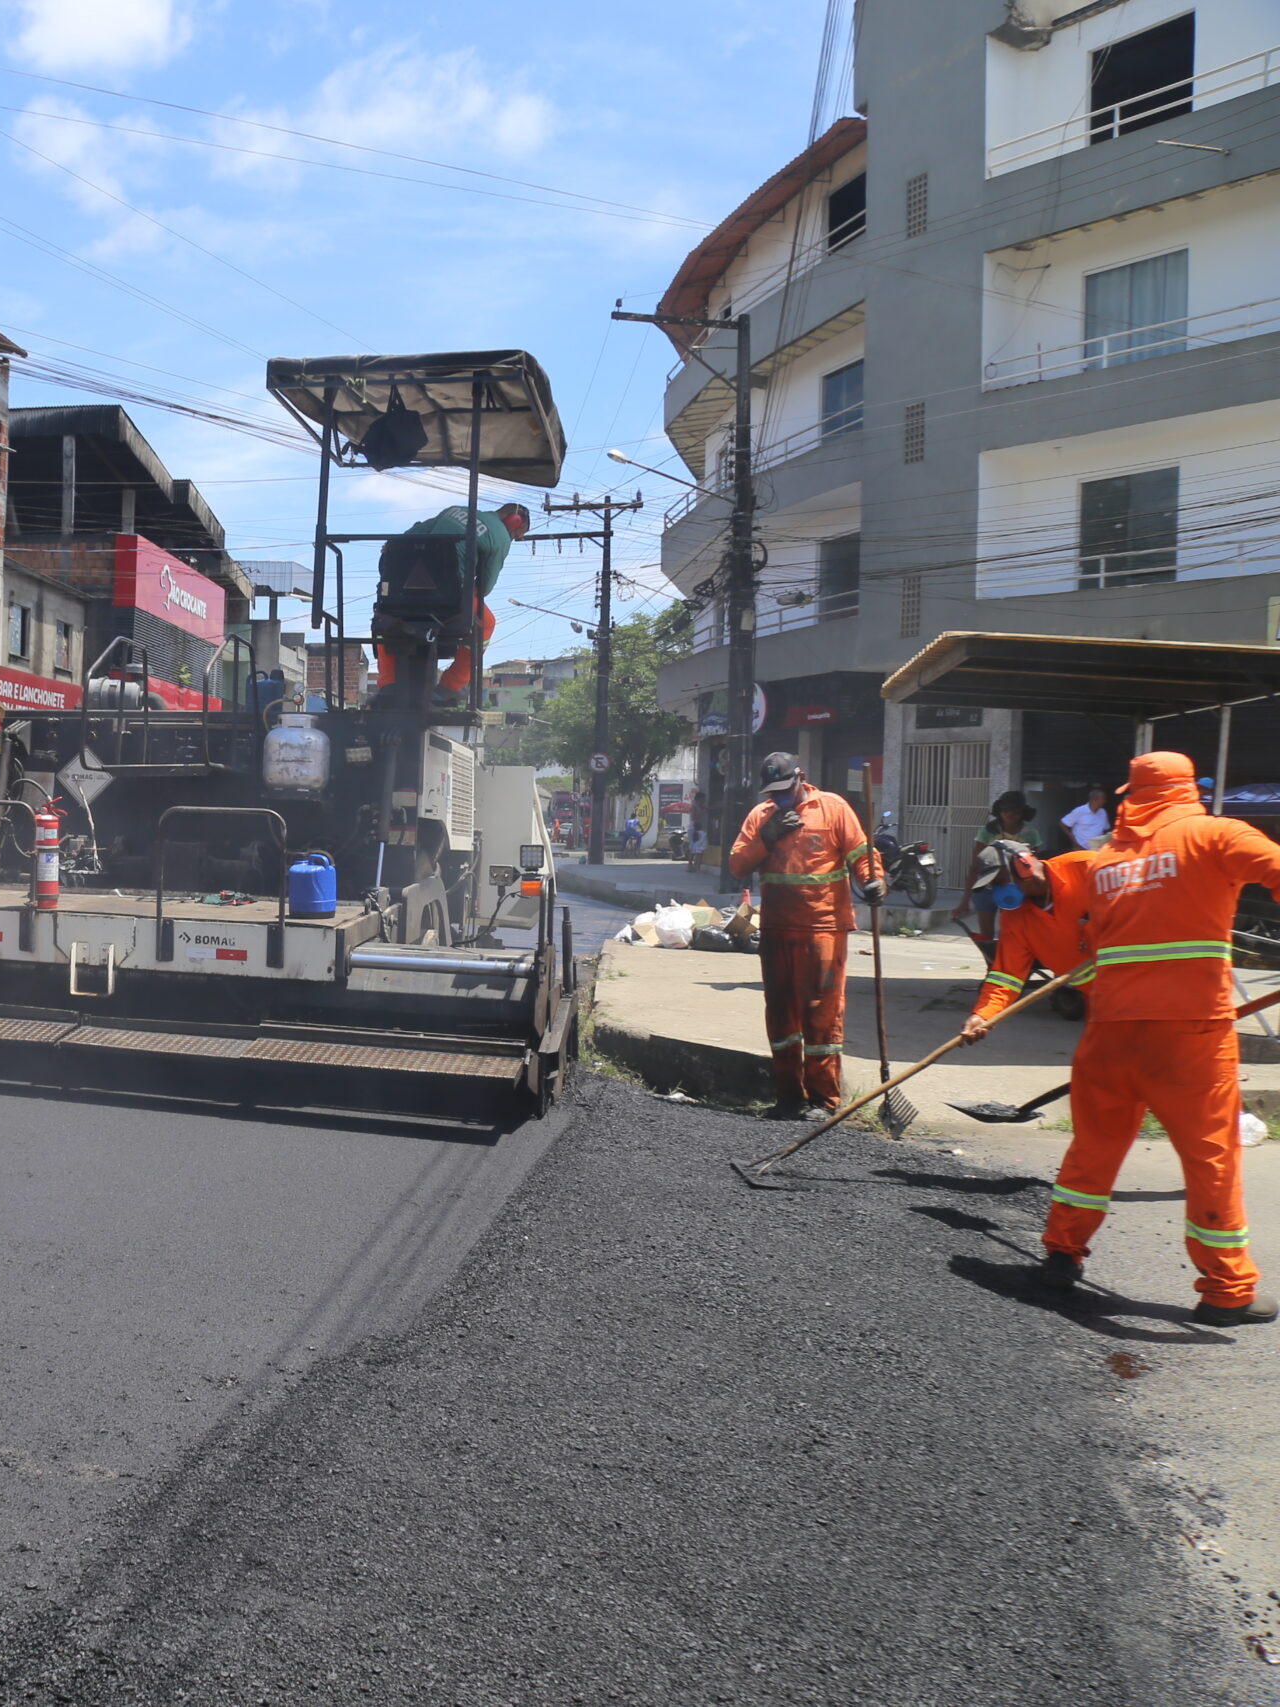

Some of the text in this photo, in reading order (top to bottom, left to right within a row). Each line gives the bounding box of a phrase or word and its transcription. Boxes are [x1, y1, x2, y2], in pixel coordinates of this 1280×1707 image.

[180, 589, 207, 620] CROCANTE
[13, 683, 19, 700] E
[19, 684, 65, 709] LANCHONETE
[1095, 851, 1177, 895] MAZZA
